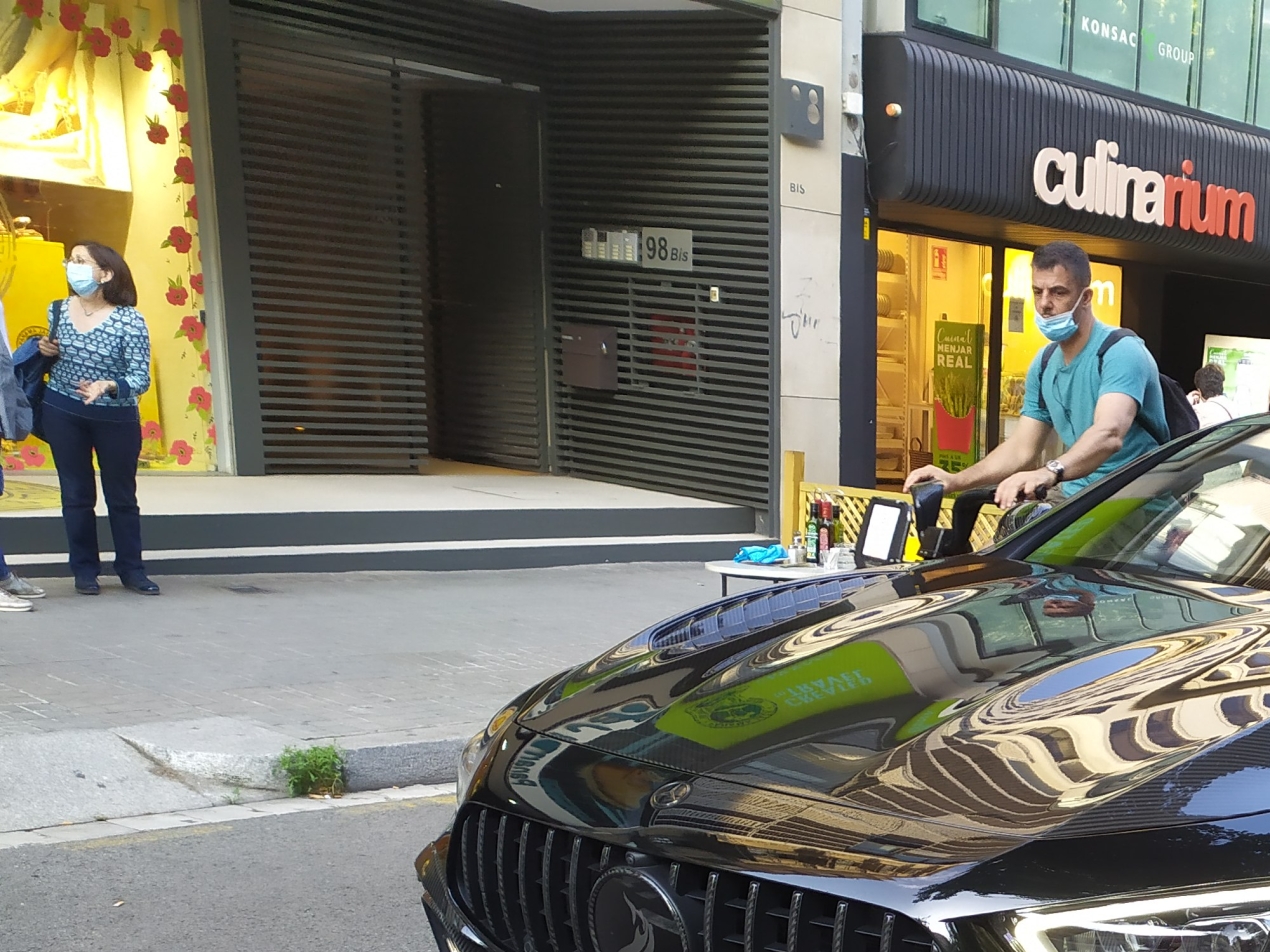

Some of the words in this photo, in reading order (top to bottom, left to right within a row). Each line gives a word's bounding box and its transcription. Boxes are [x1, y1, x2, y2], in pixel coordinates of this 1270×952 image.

[1081, 16, 1137, 48] KONSAC
[1157, 41, 1195, 65] GROUP
[789, 182, 806, 195] BIS
[1033, 139, 1256, 243] culinarium
[645, 235, 669, 261] 98
[670, 247, 689, 262] Bis
[937, 343, 973, 355] MENJAR
[937, 353, 973, 369] REAL
